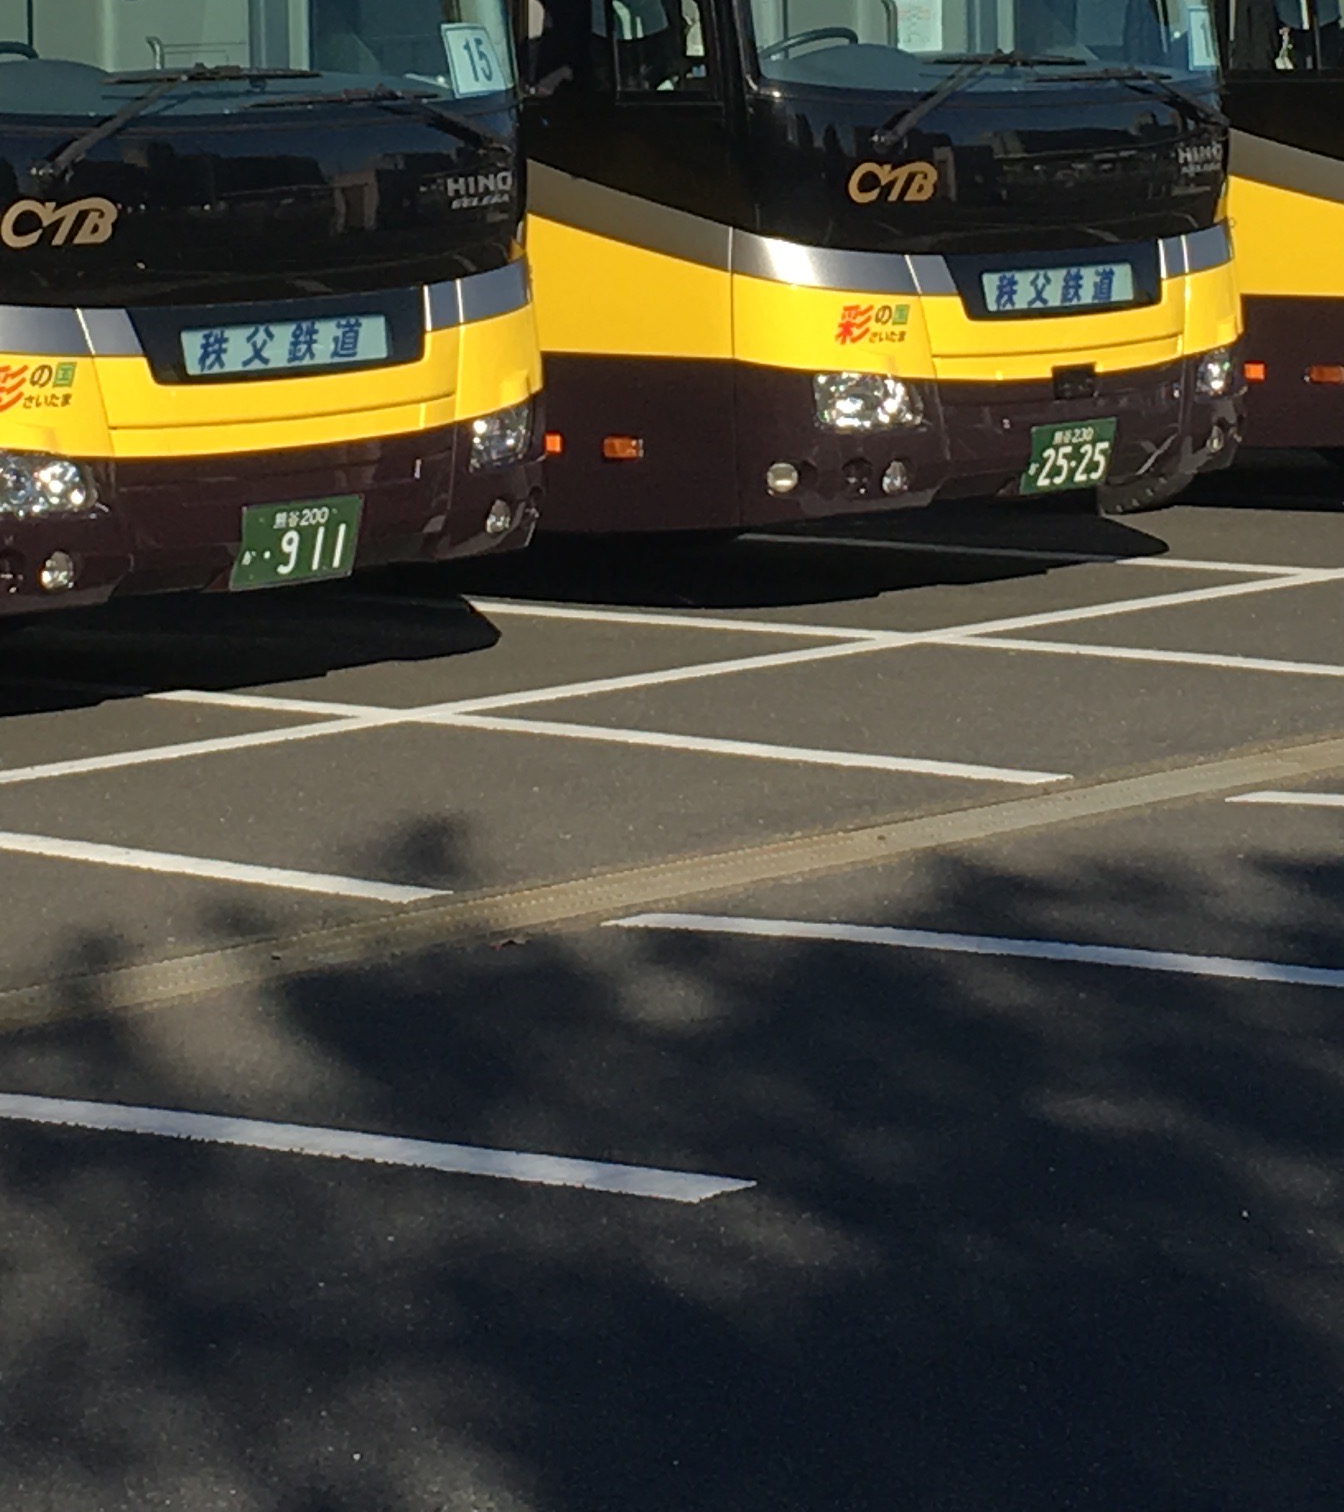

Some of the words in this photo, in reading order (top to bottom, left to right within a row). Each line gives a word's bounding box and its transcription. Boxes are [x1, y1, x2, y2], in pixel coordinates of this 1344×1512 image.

[463, 37, 493, 82] 15
[447, 171, 513, 197] HINO
[848, 161, 938, 203] CTB
[0, 197, 118, 248] CTB
[197, 317, 362, 372] 秩父鉄道
[22, 392, 73, 410] さいたま
